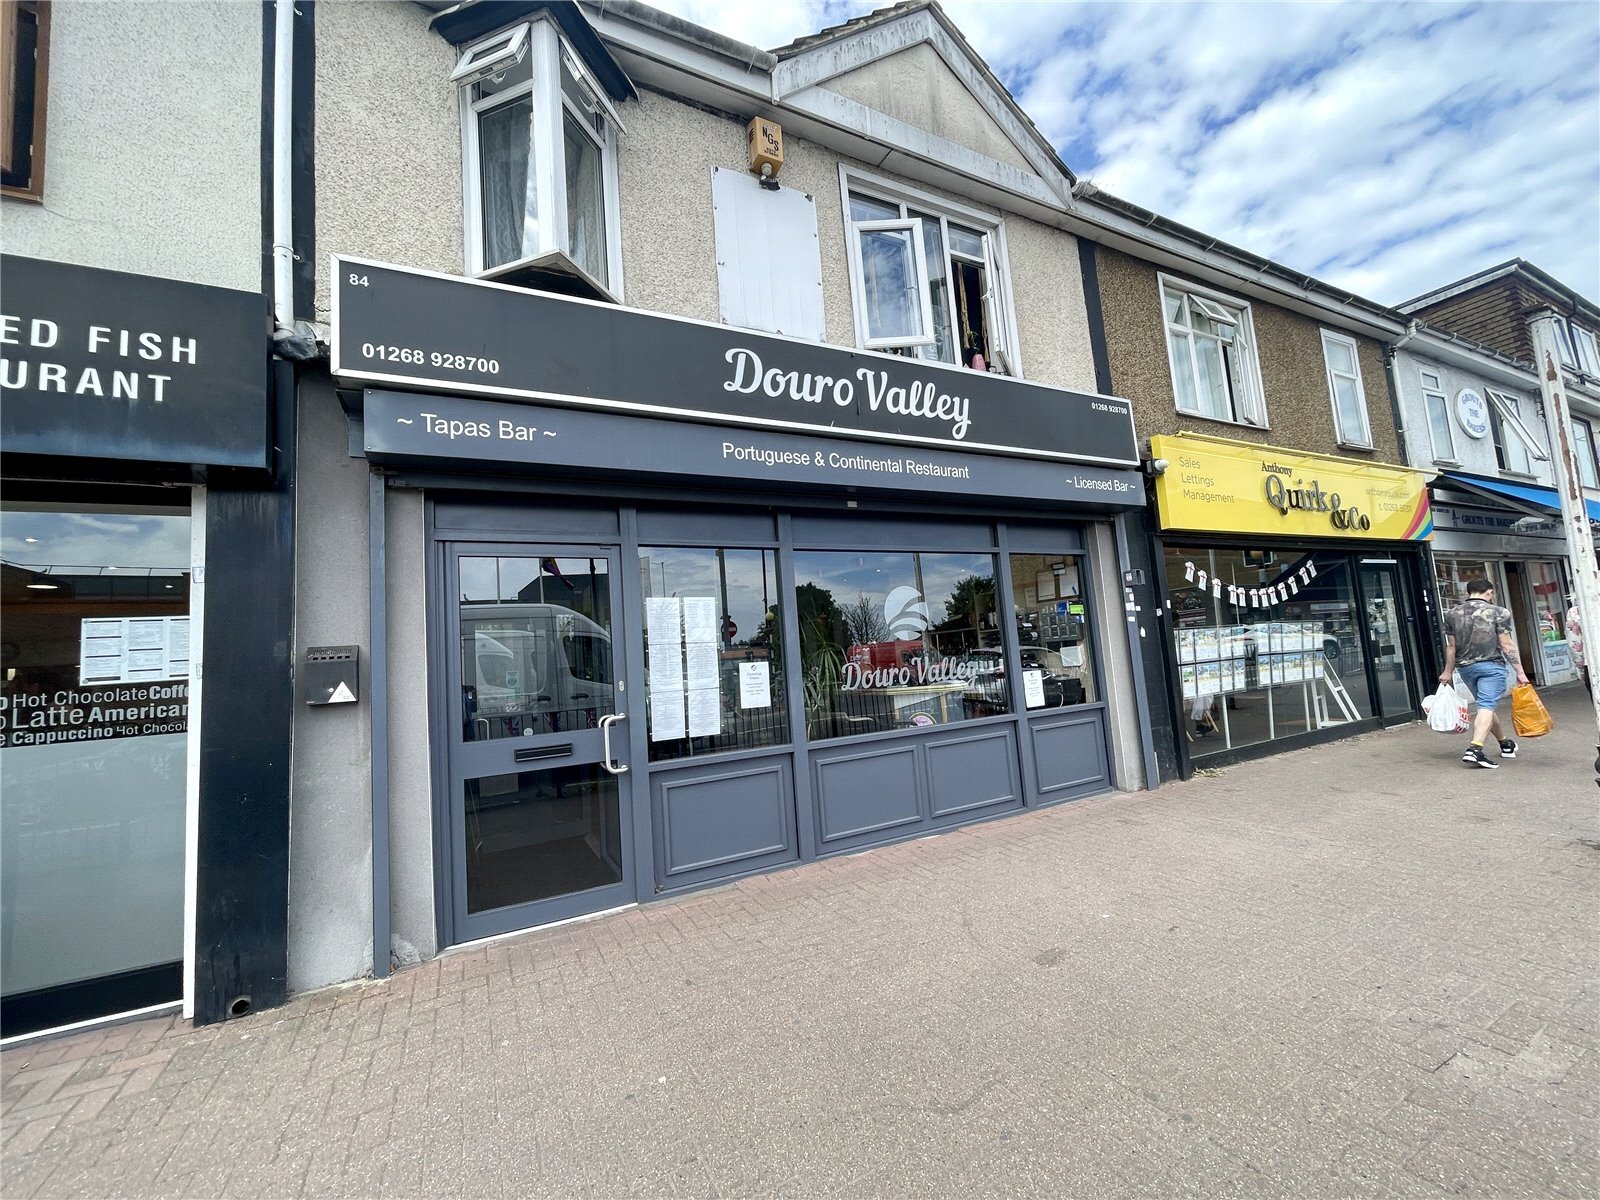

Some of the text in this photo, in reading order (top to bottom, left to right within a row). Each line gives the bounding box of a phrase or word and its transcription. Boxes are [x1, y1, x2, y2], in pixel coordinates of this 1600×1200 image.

[762, 127, 779, 152] NGS
[349, 273, 370, 287] 84
[88, 325, 197, 365] FISH
[362, 342, 500, 374] 01268 928700
[723, 348, 972, 440] Douro Valley
[1091, 402, 1128, 415] 01268 928700
[420, 413, 491, 439] Tapas
[499, 420, 537, 441] Bar
[722, 442, 970, 479] Portuguese & Continental Restaurant
[1179, 456, 1201, 469] Sales
[1261, 460, 1293, 477] Anthony
[1074, 475, 1113, 491] Licensed
[1114, 479, 1129, 492] Bar
[1181, 472, 1215, 487] Lettings
[1183, 489, 1236, 504] Management
[1265, 474, 1330, 516] Quirk
[841, 655, 978, 692] Douro Valley
[13, 693, 48, 708] Hot
[54, 687, 148, 706] Chocolate
[12, 706, 84, 729] Latte
[12, 726, 113, 746] Cappuccino
